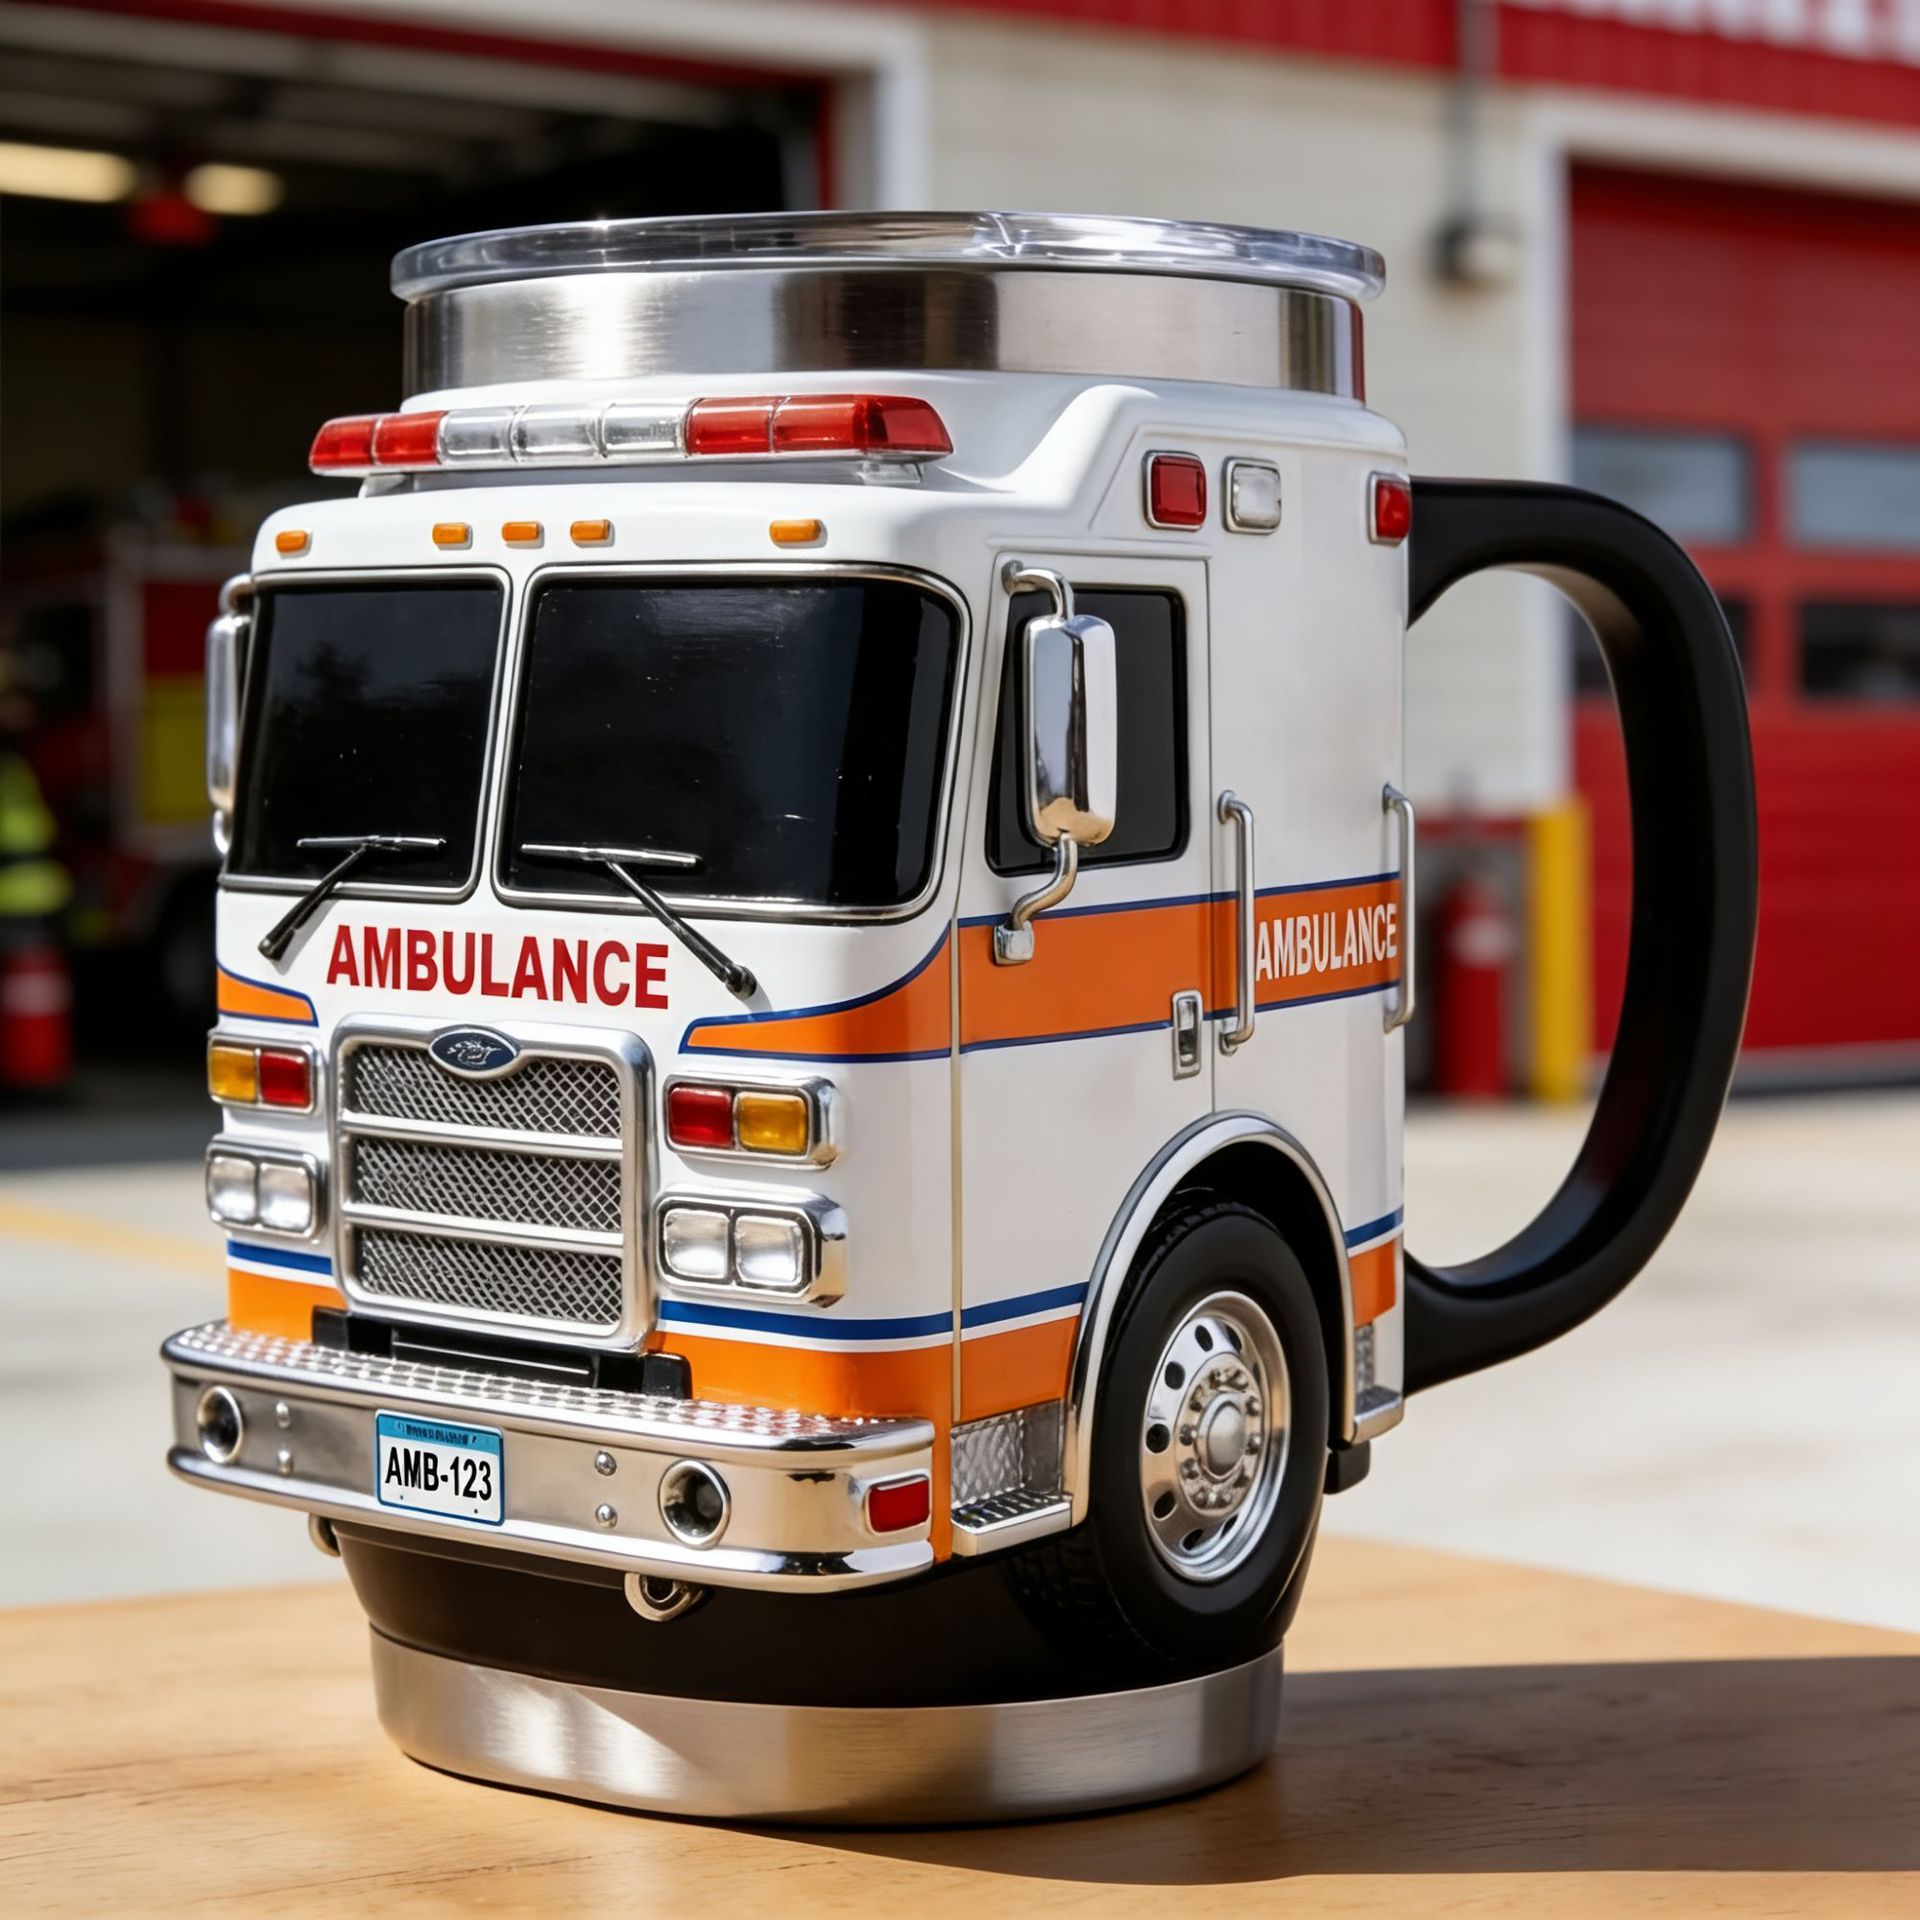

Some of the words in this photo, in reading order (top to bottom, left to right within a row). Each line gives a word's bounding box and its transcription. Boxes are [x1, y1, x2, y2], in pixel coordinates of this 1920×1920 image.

[326, 924, 669, 1010] AMBULANCE
[1255, 903, 1398, 982] AMBULANCE
[385, 1446, 492, 1501] AMB-123
